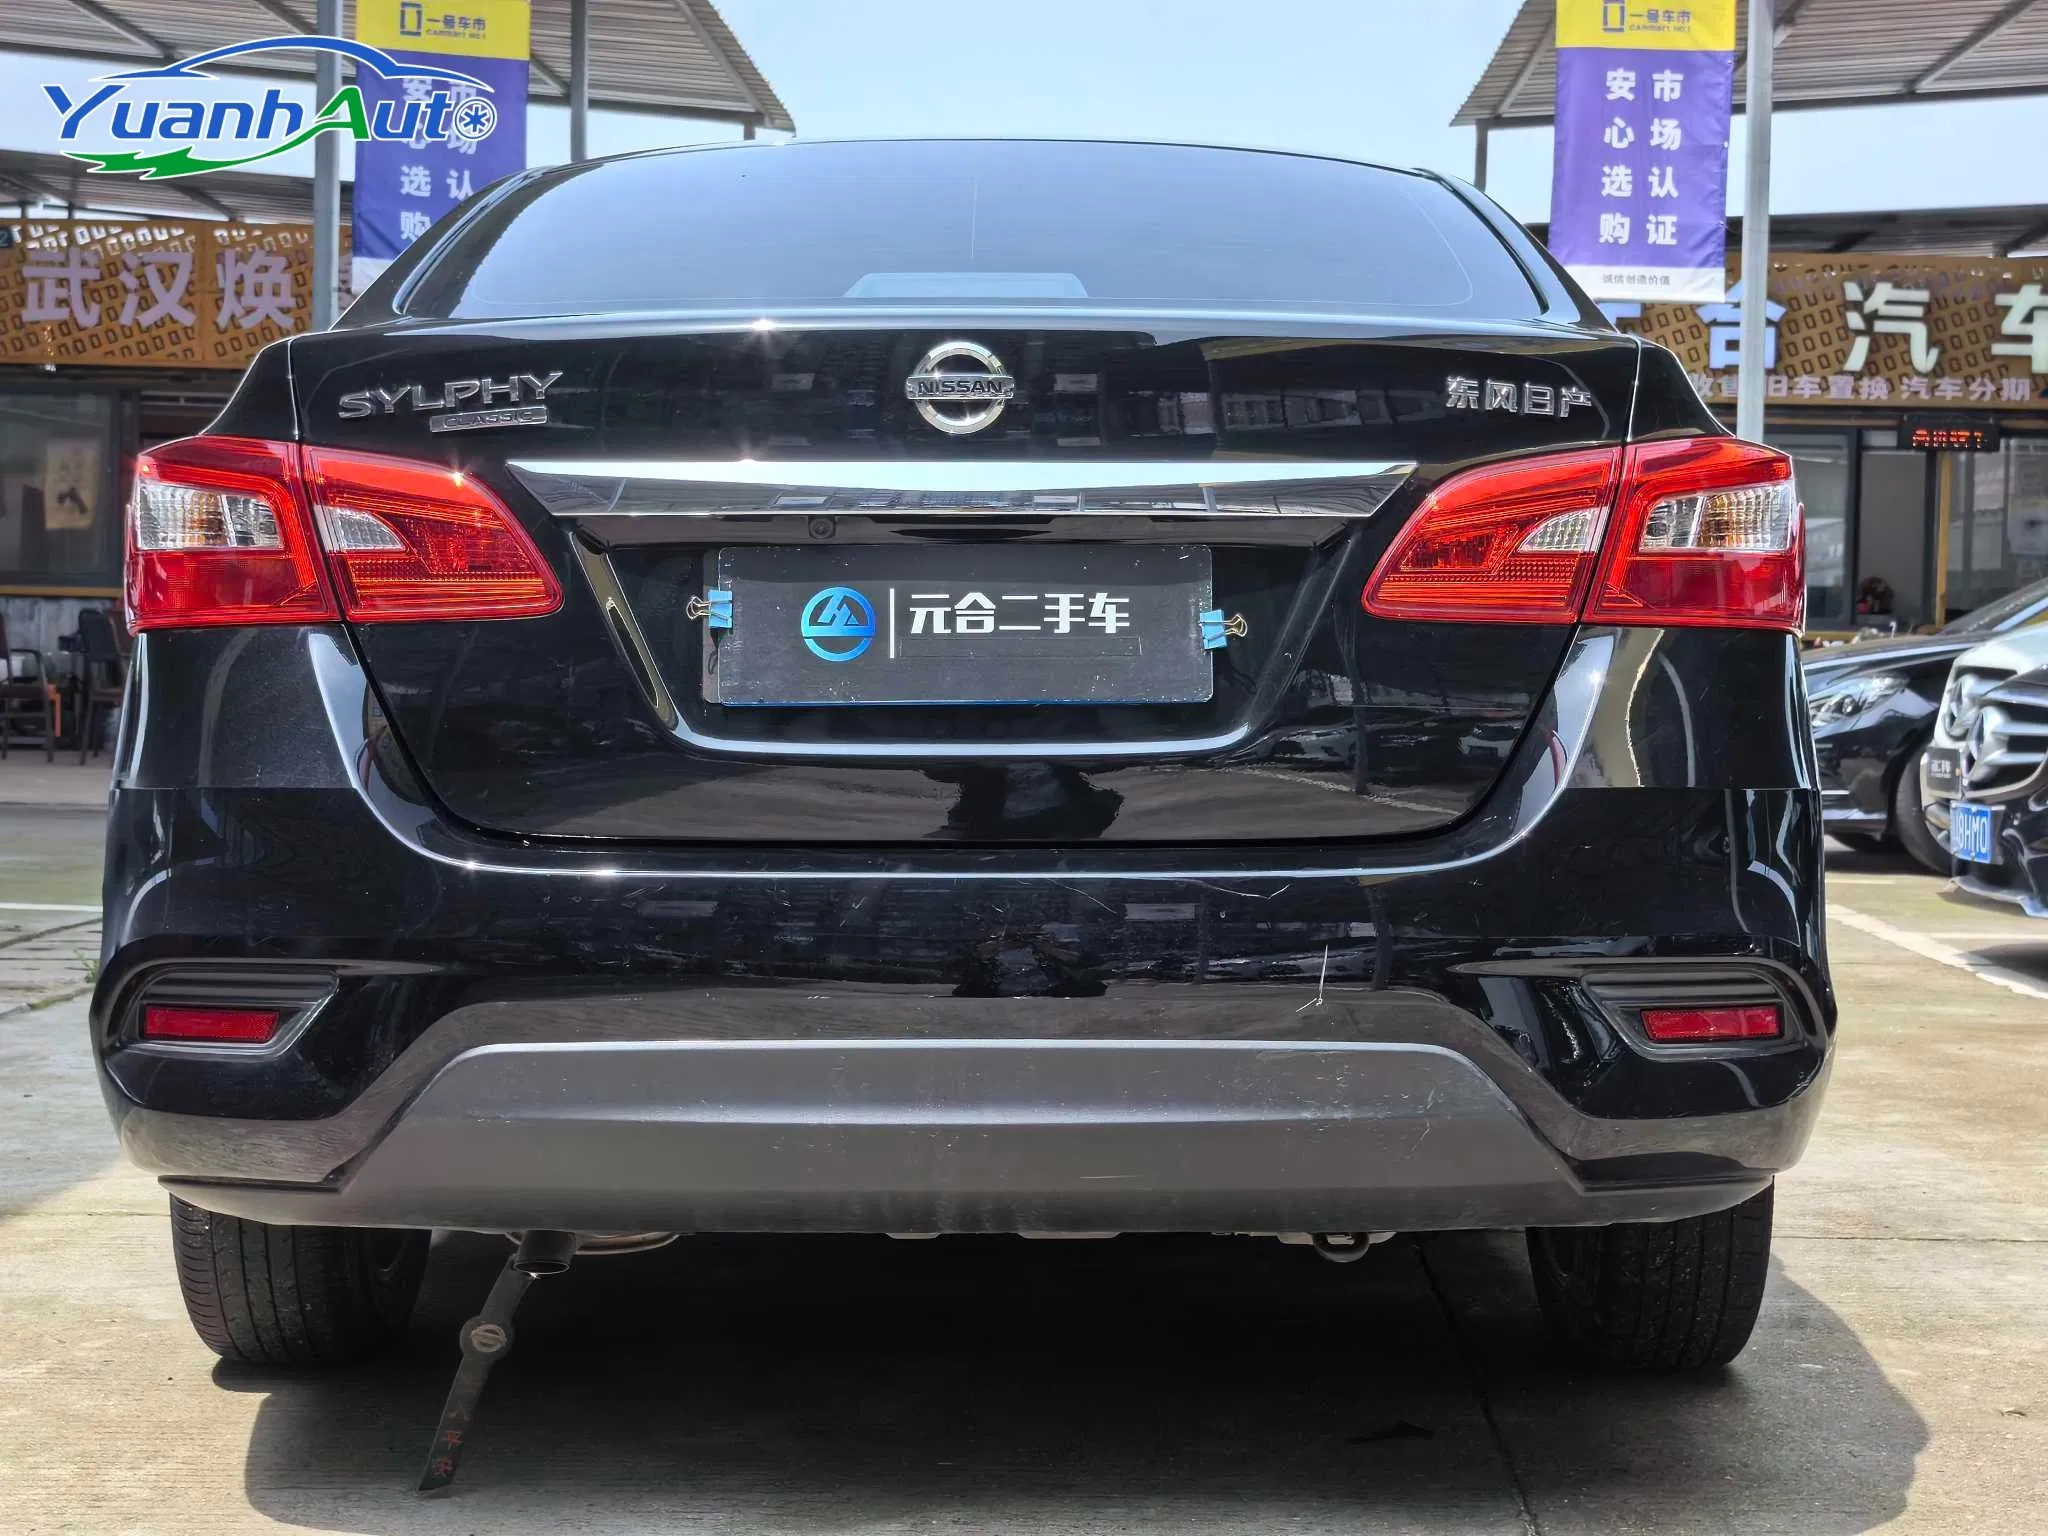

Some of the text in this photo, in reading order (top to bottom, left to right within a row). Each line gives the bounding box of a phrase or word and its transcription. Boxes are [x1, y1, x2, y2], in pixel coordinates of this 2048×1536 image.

[1599, 68, 1636, 245] 安心选购
[1646, 69, 1684, 245] 市场认证
[20, 247, 298, 328] 武汉焕
[338, 371, 563, 419] SYLPHY
[918, 380, 1003, 394] NISSAN
[1446, 376, 1592, 418] 东风日产
[1901, 376, 2031, 401] 汽车分期
[443, 411, 536, 428] CLASSIC
[908, 591, 1131, 635] 元合二手车
